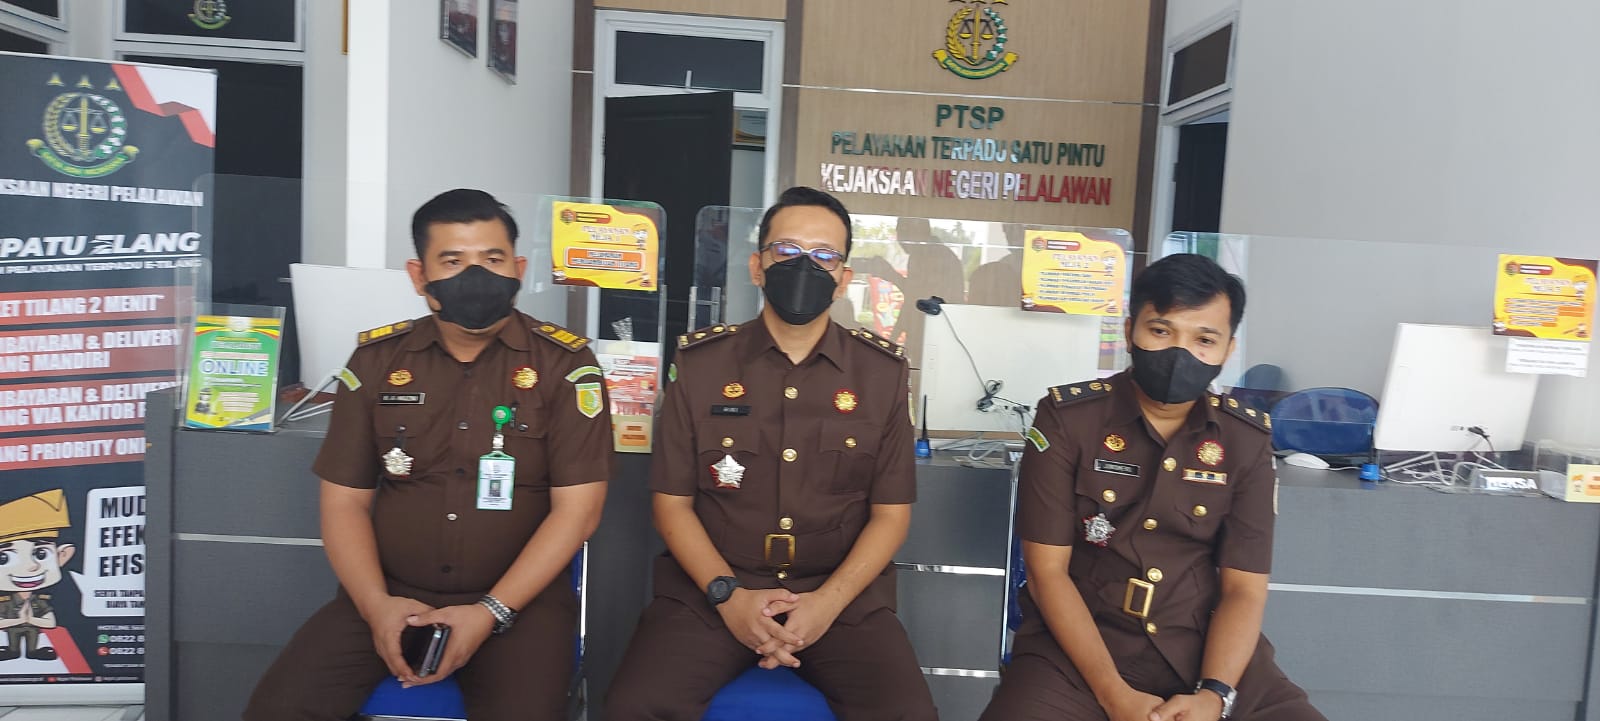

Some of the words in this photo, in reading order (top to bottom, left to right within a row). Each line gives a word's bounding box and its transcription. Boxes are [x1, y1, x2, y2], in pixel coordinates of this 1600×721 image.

[936, 104, 1005, 130] PTSP
[831, 131, 926, 158] PELAYANAN
[932, 136, 1007, 163] TERPADU
[1011, 140, 1052, 165] SATU
[1057, 143, 1105, 167] PINTU
[52, 182, 109, 201] NEGERI
[111, 186, 204, 207] PELALAWAN
[820, 163, 927, 197] KEJAKSAAN
[932, 169, 999, 200] NEGERI
[1003, 172, 1112, 206] PELALAWAN
[0, 235, 88, 258] PATU
[24, 297, 88, 316] TILANG
[89, 297, 102, 314] 2
[86, 336, 100, 349] &
[103, 329, 184, 348] DELIVERY
[33, 351, 110, 371] MANDIRI
[200, 360, 268, 376] ONLINE
[85, 388, 99, 402] &
[31, 407, 63, 425] VIA
[65, 403, 135, 422] KANTOR
[31, 440, 113, 460] PRIORITY
[100, 554, 143, 577] EFIS
